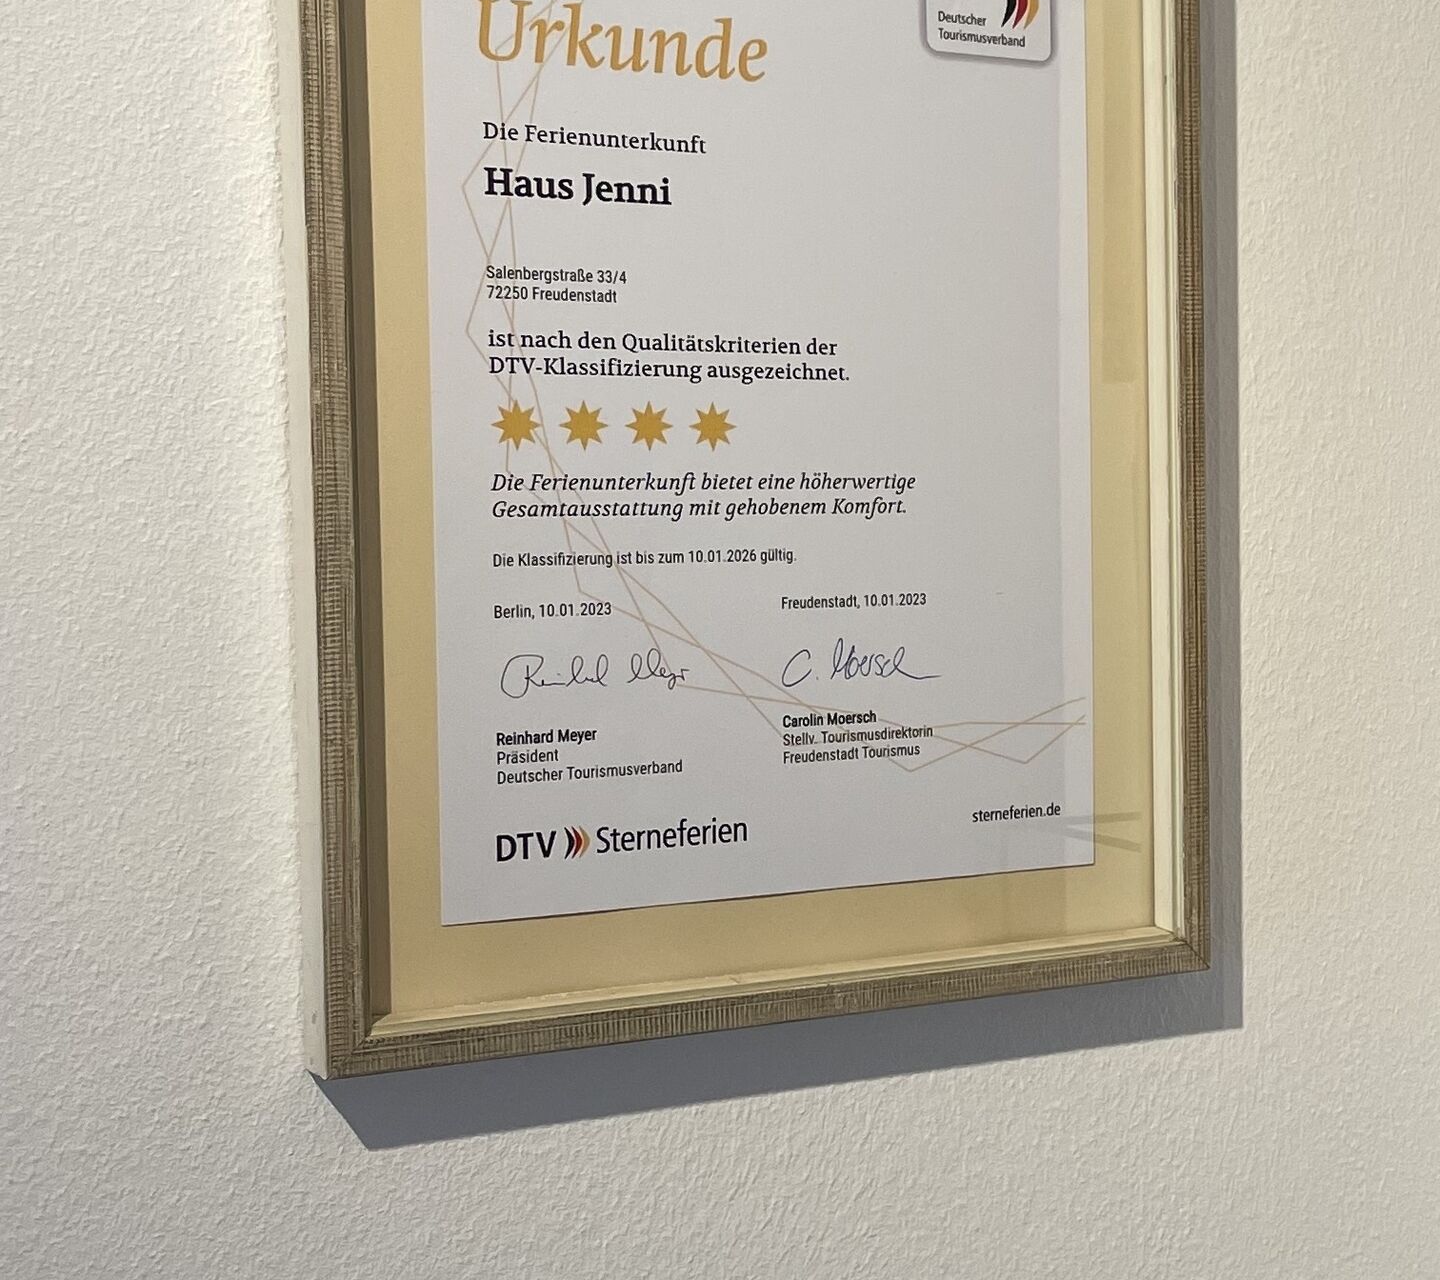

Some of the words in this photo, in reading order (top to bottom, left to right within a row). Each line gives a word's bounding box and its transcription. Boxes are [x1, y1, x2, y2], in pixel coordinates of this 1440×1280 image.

[938, 11, 987, 26] Deutscher
[938, 29, 1026, 48] Tourismusverband
[483, 122, 519, 141] Die
[525, 124, 707, 154] Ferienunterkunft
[484, 167, 574, 201] Haus
[582, 173, 672, 206] Jenni
[485, 265, 593, 285] Salenbergstraße
[597, 268, 627, 284] 33/4
[487, 285, 528, 302] 72250
[532, 286, 617, 304] Freudenstadt
[488, 330, 515, 348] ist
[520, 330, 572, 350] nach
[578, 331, 616, 351] den
[622, 332, 800, 357] Qualitätskriterien
[806, 336, 838, 356] der
[489, 356, 702, 383] DTV-Klassifizierung
[707, 359, 851, 385] ausgezeichnet.
[491, 472, 524, 492] Die
[530, 472, 695, 494] Ferienunterkunft
[701, 472, 752, 491] bietet
[758, 474, 795, 491] eine
[800, 472, 916, 494] höherwertige
[492, 499, 683, 521] Gesamtausstattung
[689, 499, 720, 517] mit
[725, 498, 826, 520] gehobenem
[832, 495, 907, 519] Komfort.
[493, 552, 514, 568] Die
[518, 551, 613, 569] Klassifizierung
[616, 551, 632, 565] ist
[636, 550, 654, 565] bis
[657, 552, 684, 565] zum
[688, 549, 757, 565] 10.01.2026
[760, 547, 797, 566] gültig.
[494, 603, 536, 620] Berlin,
[539, 602, 612, 618] 10.01.2023
[782, 594, 860, 611] Freudenstadt,
[863, 593, 927, 607] 10.01.2023
[783, 712, 823, 728] Carolin
[827, 711, 877, 725] Moersch
[496, 729, 554, 746] Reinhard
[557, 727, 597, 745] Meyer
[783, 730, 818, 747] Stellv.
[821, 725, 934, 743] Tourismusdirektorin
[497, 747, 559, 765] Präsident
[783, 746, 859, 765] Freudenstadt
[862, 743, 920, 760] Tourismus
[497, 765, 563, 784] Deutscher
[566, 759, 683, 781] Tourismusverband
[972, 802, 1061, 822] sterneferien.de
[496, 830, 556, 863] DTV
[596, 818, 748, 855] Sterneferien
